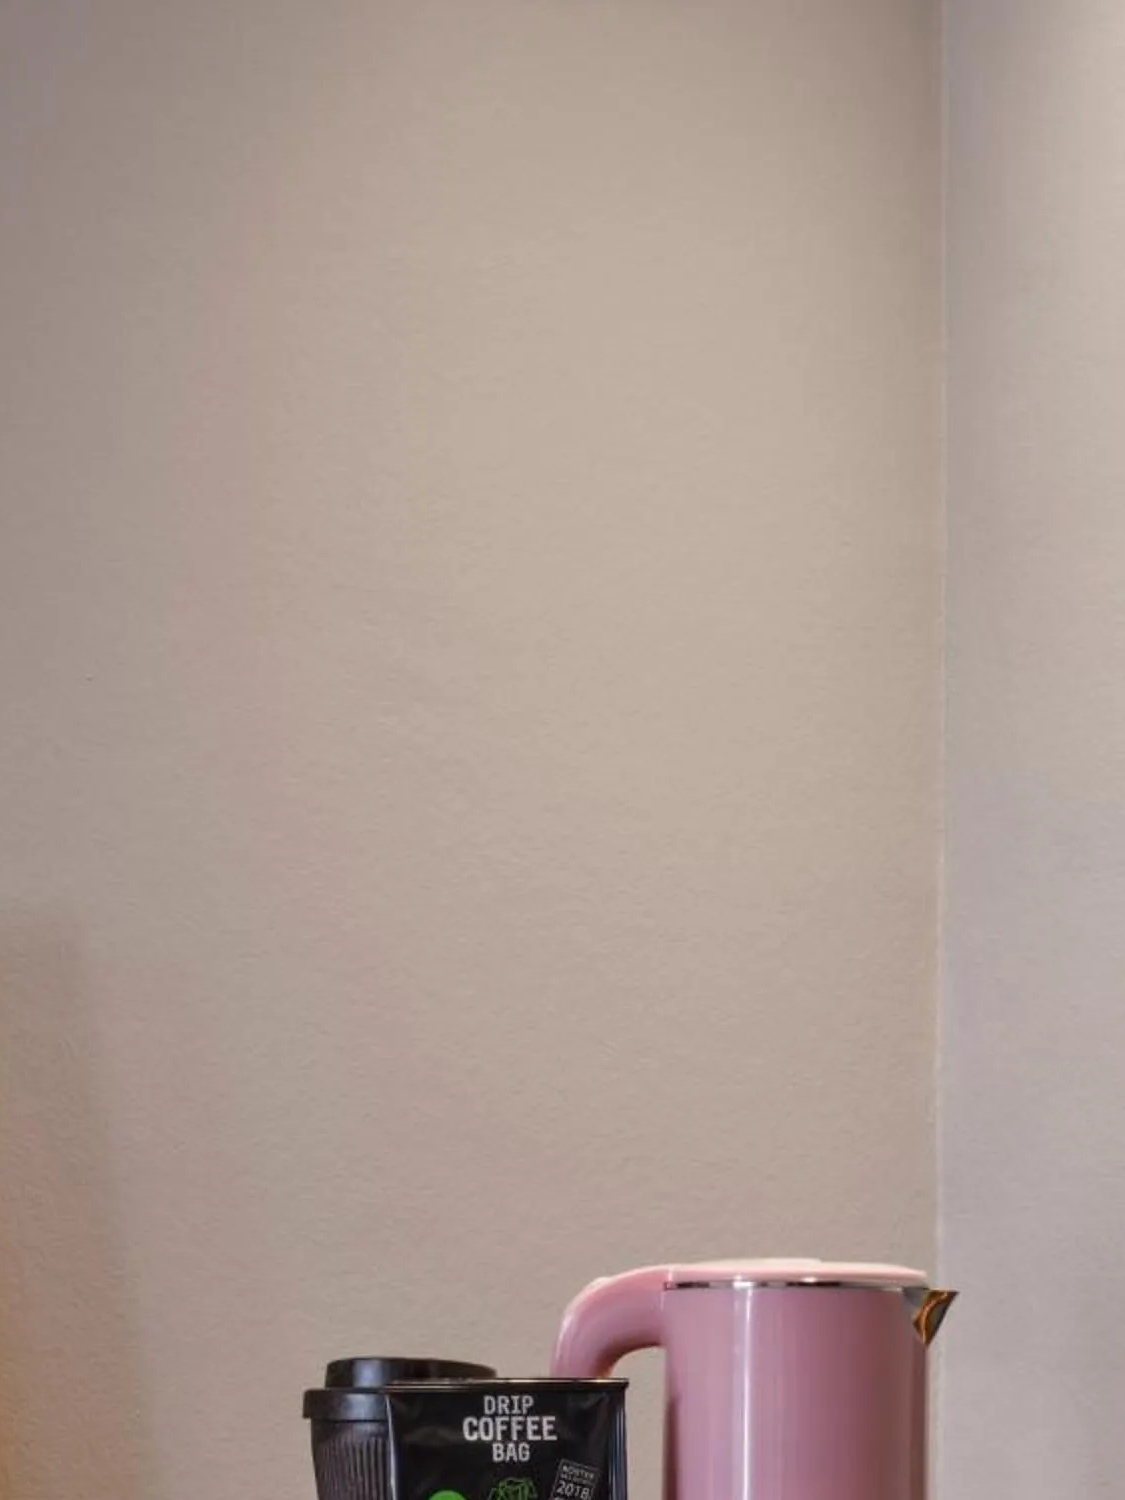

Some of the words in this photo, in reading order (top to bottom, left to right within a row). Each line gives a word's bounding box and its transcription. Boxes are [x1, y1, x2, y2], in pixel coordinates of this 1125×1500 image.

[483, 1395, 534, 1415] DRIP
[462, 1415, 558, 1441] COFFEE
[492, 1442, 530, 1463] BAG
[556, 1480, 590, 1500] 2018
